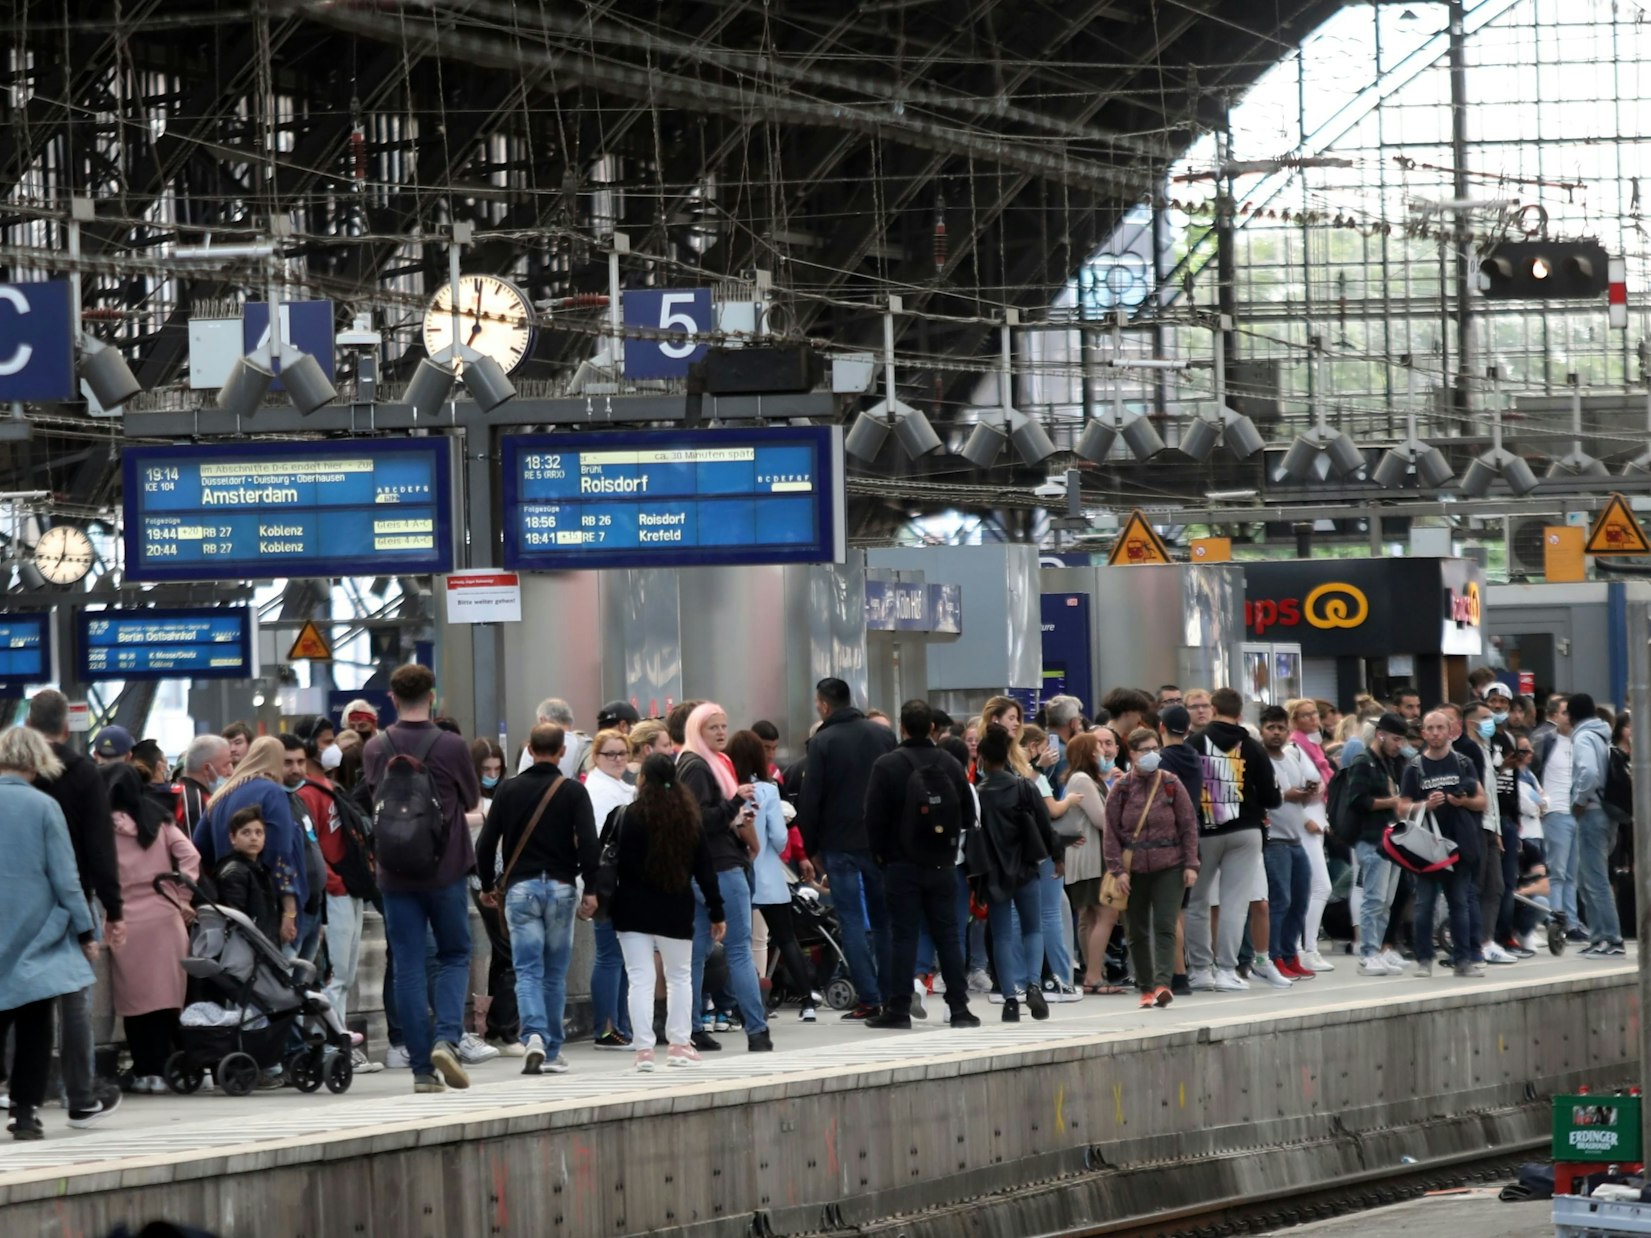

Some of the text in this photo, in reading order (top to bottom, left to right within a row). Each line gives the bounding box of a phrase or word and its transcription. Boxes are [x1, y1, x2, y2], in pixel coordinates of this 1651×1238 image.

[658, 293, 698, 359] 5
[525, 455, 561, 469] 18:32
[685, 451, 725, 460] Minuten
[146, 467, 179, 481] 19:14
[216, 464, 269, 473] Abschnitte
[291, 462, 320, 471] endet
[324, 461, 343, 469] hier
[581, 465, 602, 474] Brühl
[201, 475, 245, 486] Düsseldorf
[253, 475, 289, 485] Duisburg
[297, 473, 345, 483] Oberhausen
[524, 470, 565, 480] RE 5 (RRX)
[145, 482, 175, 491] ICE 104
[581, 475, 648, 493] Roisdorf
[202, 487, 298, 504] Amsterdam
[525, 513, 685, 528] 18:56 RB 26 Roisdorf
[146, 528, 177, 540] 19:44
[203, 528, 216, 538] RB
[219, 527, 232, 537] 27
[259, 525, 303, 537] Koblenz
[377, 521, 401, 529] Gleis
[525, 533, 556, 545] 18:41
[582, 532, 595, 542] RE
[599, 532, 605, 541] 7
[639, 530, 681, 541] Krefeld
[146, 545, 177, 556] 20:44
[203, 544, 216, 554] RB
[220, 543, 232, 554] 27
[260, 541, 303, 553] Koblenz
[377, 537, 401, 545] Gleis
[118, 631, 197, 643] Berlin Ostbahnhof
[1569, 1130, 1618, 1146] ERDINGER
